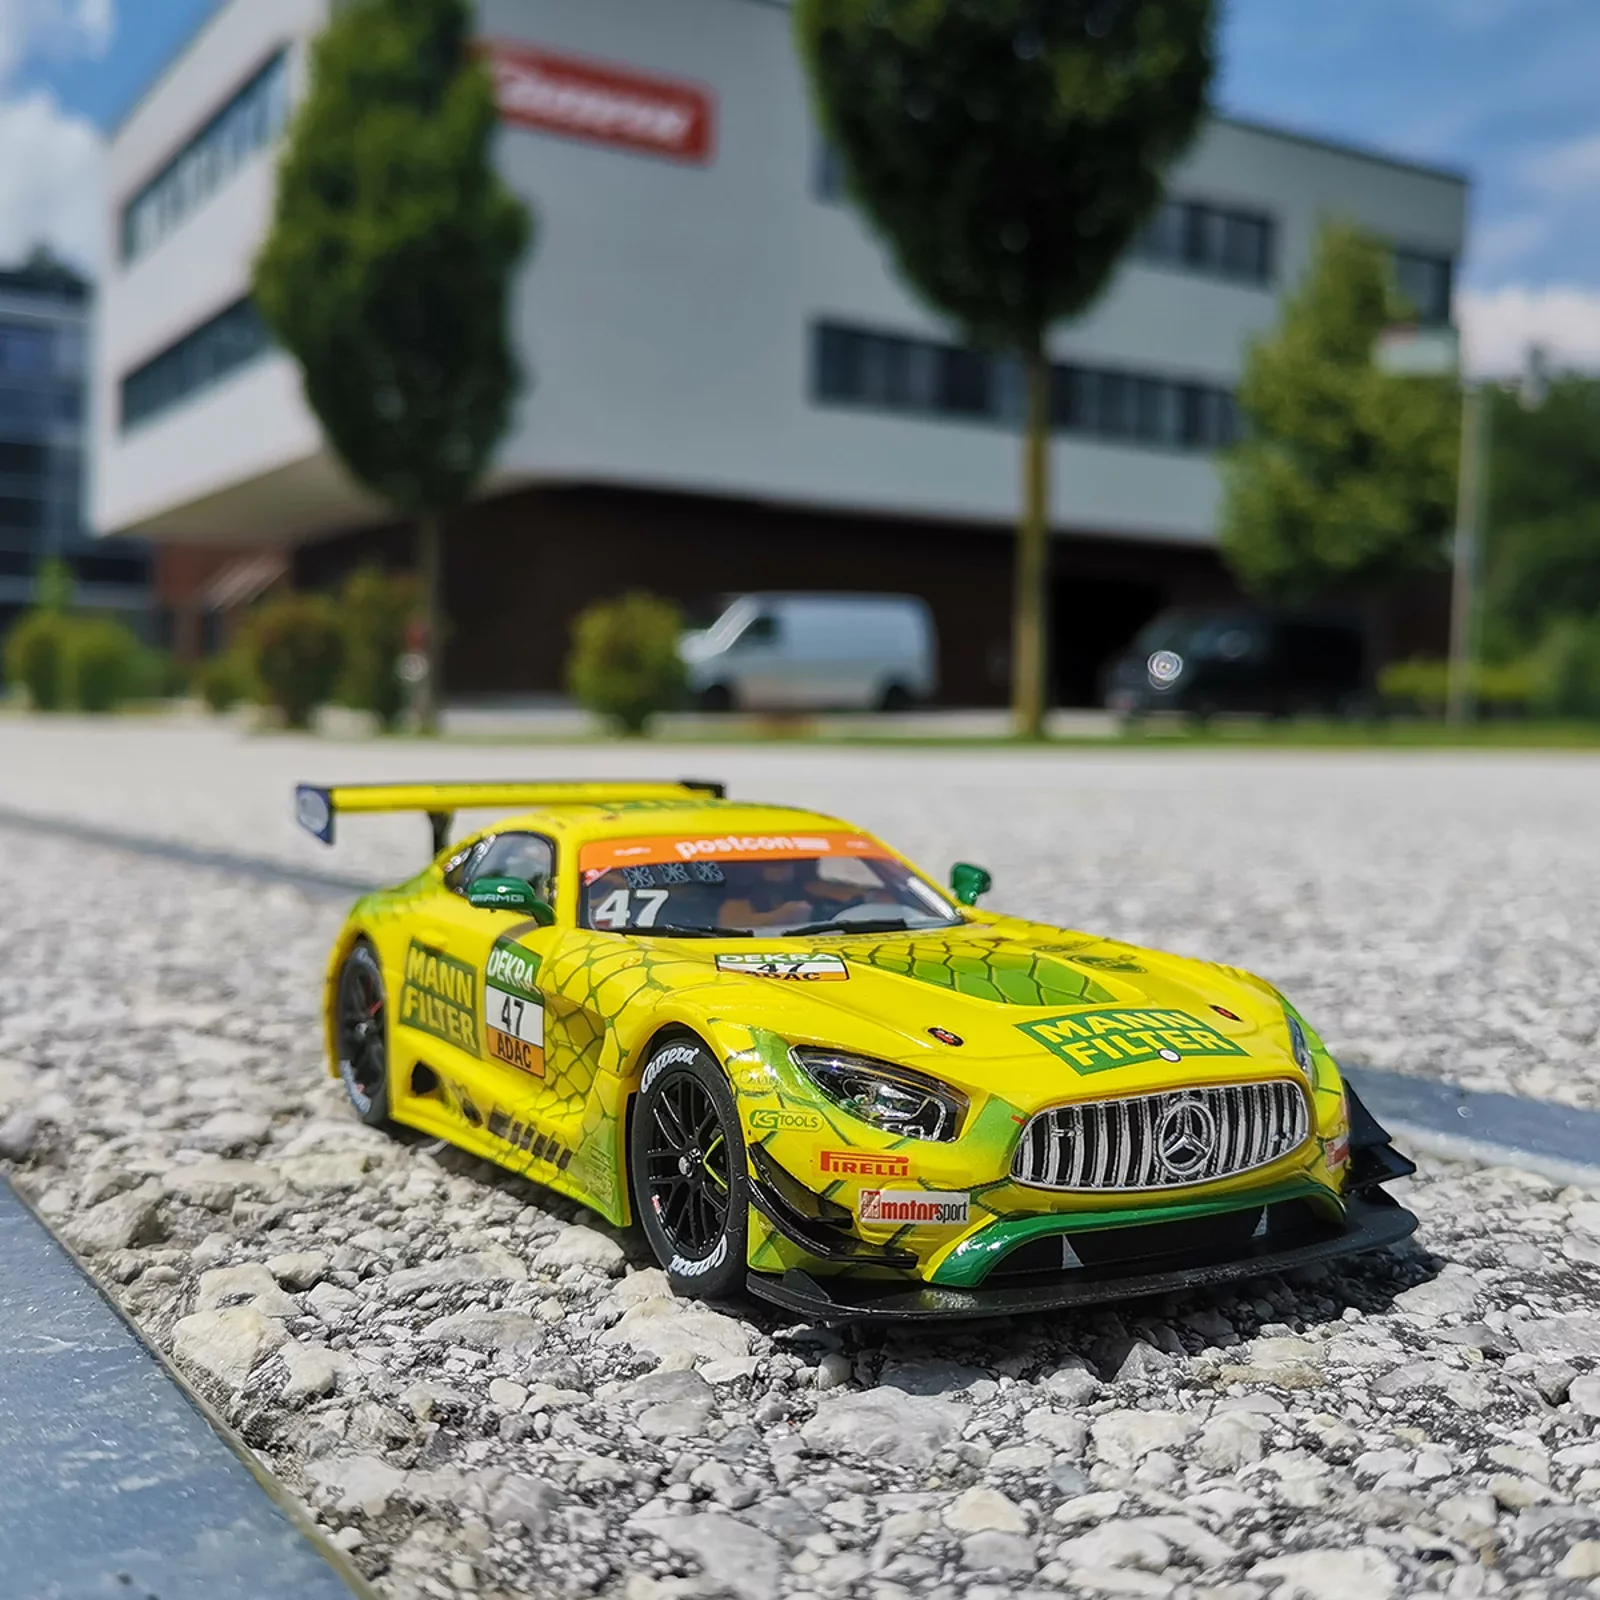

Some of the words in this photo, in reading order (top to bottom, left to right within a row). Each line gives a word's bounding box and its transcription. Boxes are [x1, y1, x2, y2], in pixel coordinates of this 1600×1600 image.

[674, 836, 796, 860] postcon
[484, 893, 525, 903] AMG
[594, 889, 669, 929] 47
[487, 946, 542, 997] DEKRA
[719, 953, 841, 962] DEKRA
[757, 963, 805, 973] 47
[407, 947, 473, 1010] MANN
[402, 985, 477, 1050] FILTER
[501, 996, 525, 1037] 47
[1031, 1012, 1204, 1044] MANN
[496, 1033, 532, 1069] ADAC
[1061, 1030, 1236, 1067] FILTER
[640, 1046, 700, 1094] Carrera
[778, 1114, 819, 1128] TOOLS
[820, 1151, 910, 1177] PIRELLI
